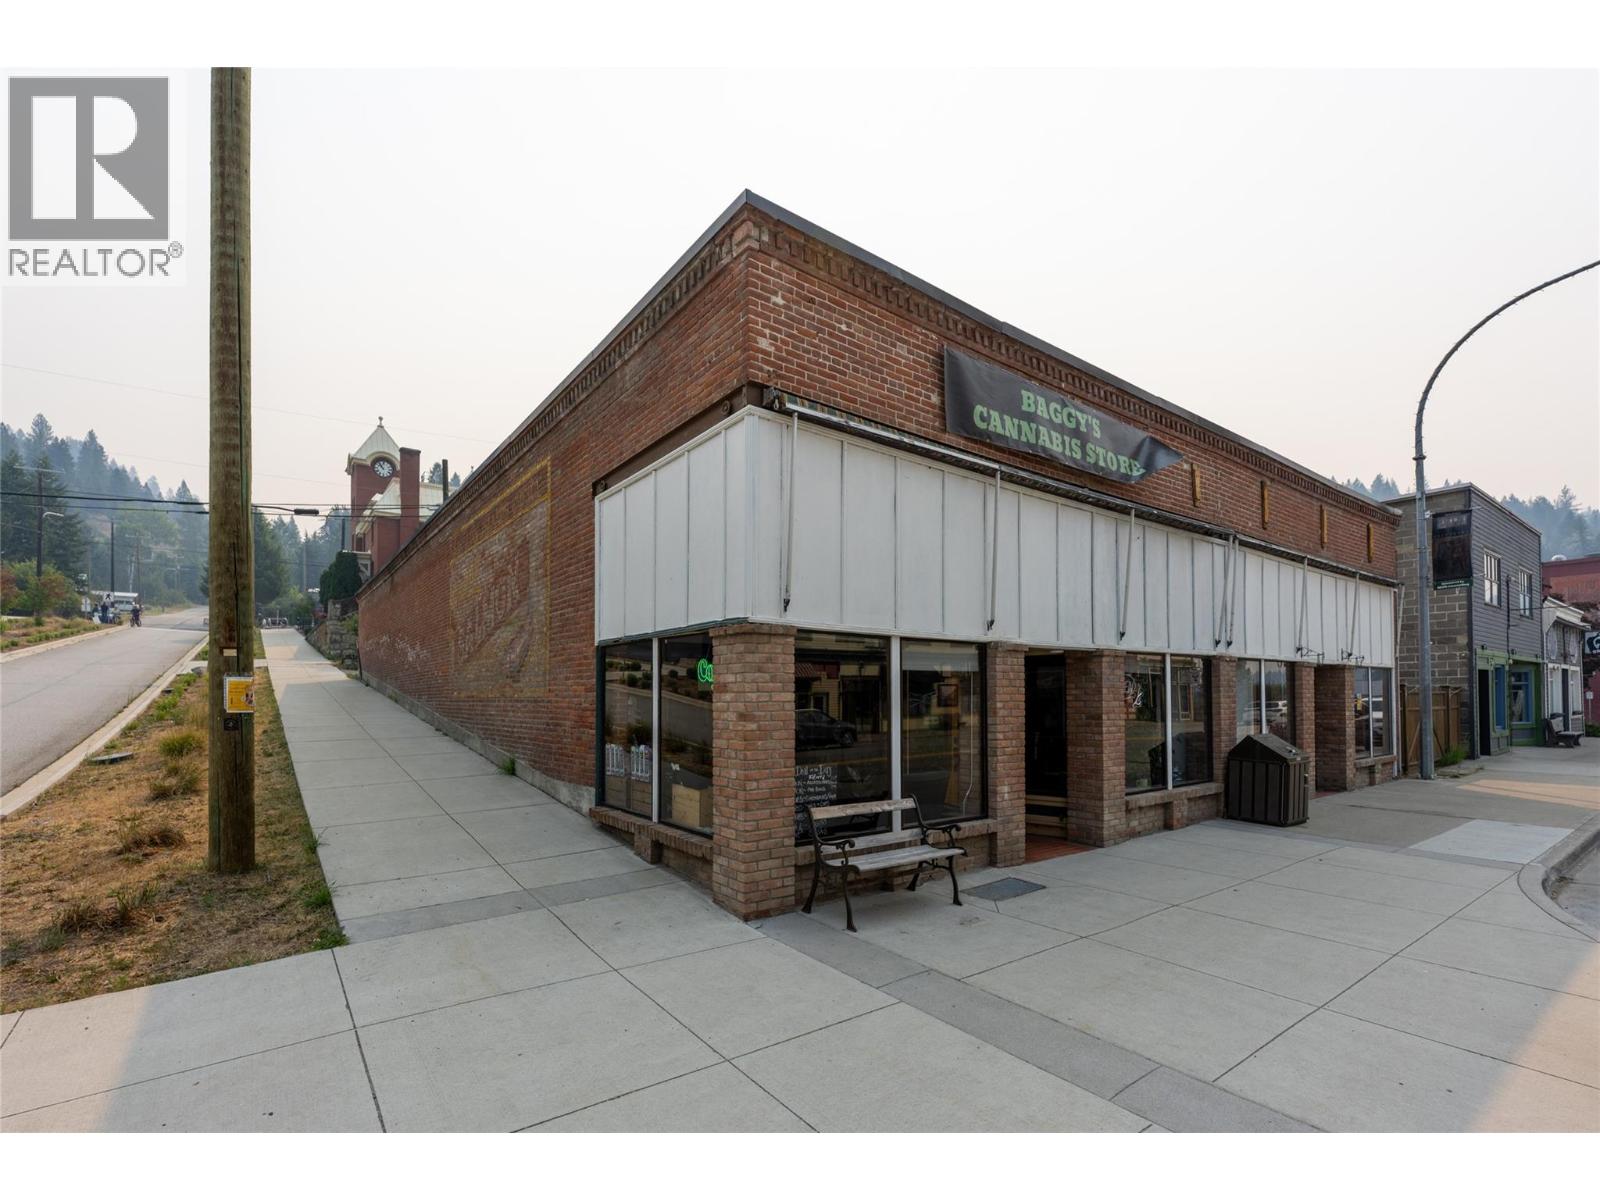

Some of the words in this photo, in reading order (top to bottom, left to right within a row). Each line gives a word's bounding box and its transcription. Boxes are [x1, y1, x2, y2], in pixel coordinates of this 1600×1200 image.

[973, 404, 1081, 460] CANNABIS
[1086, 442, 1146, 476] STORE
[1020, 389, 1101, 439] BAGGY'S
